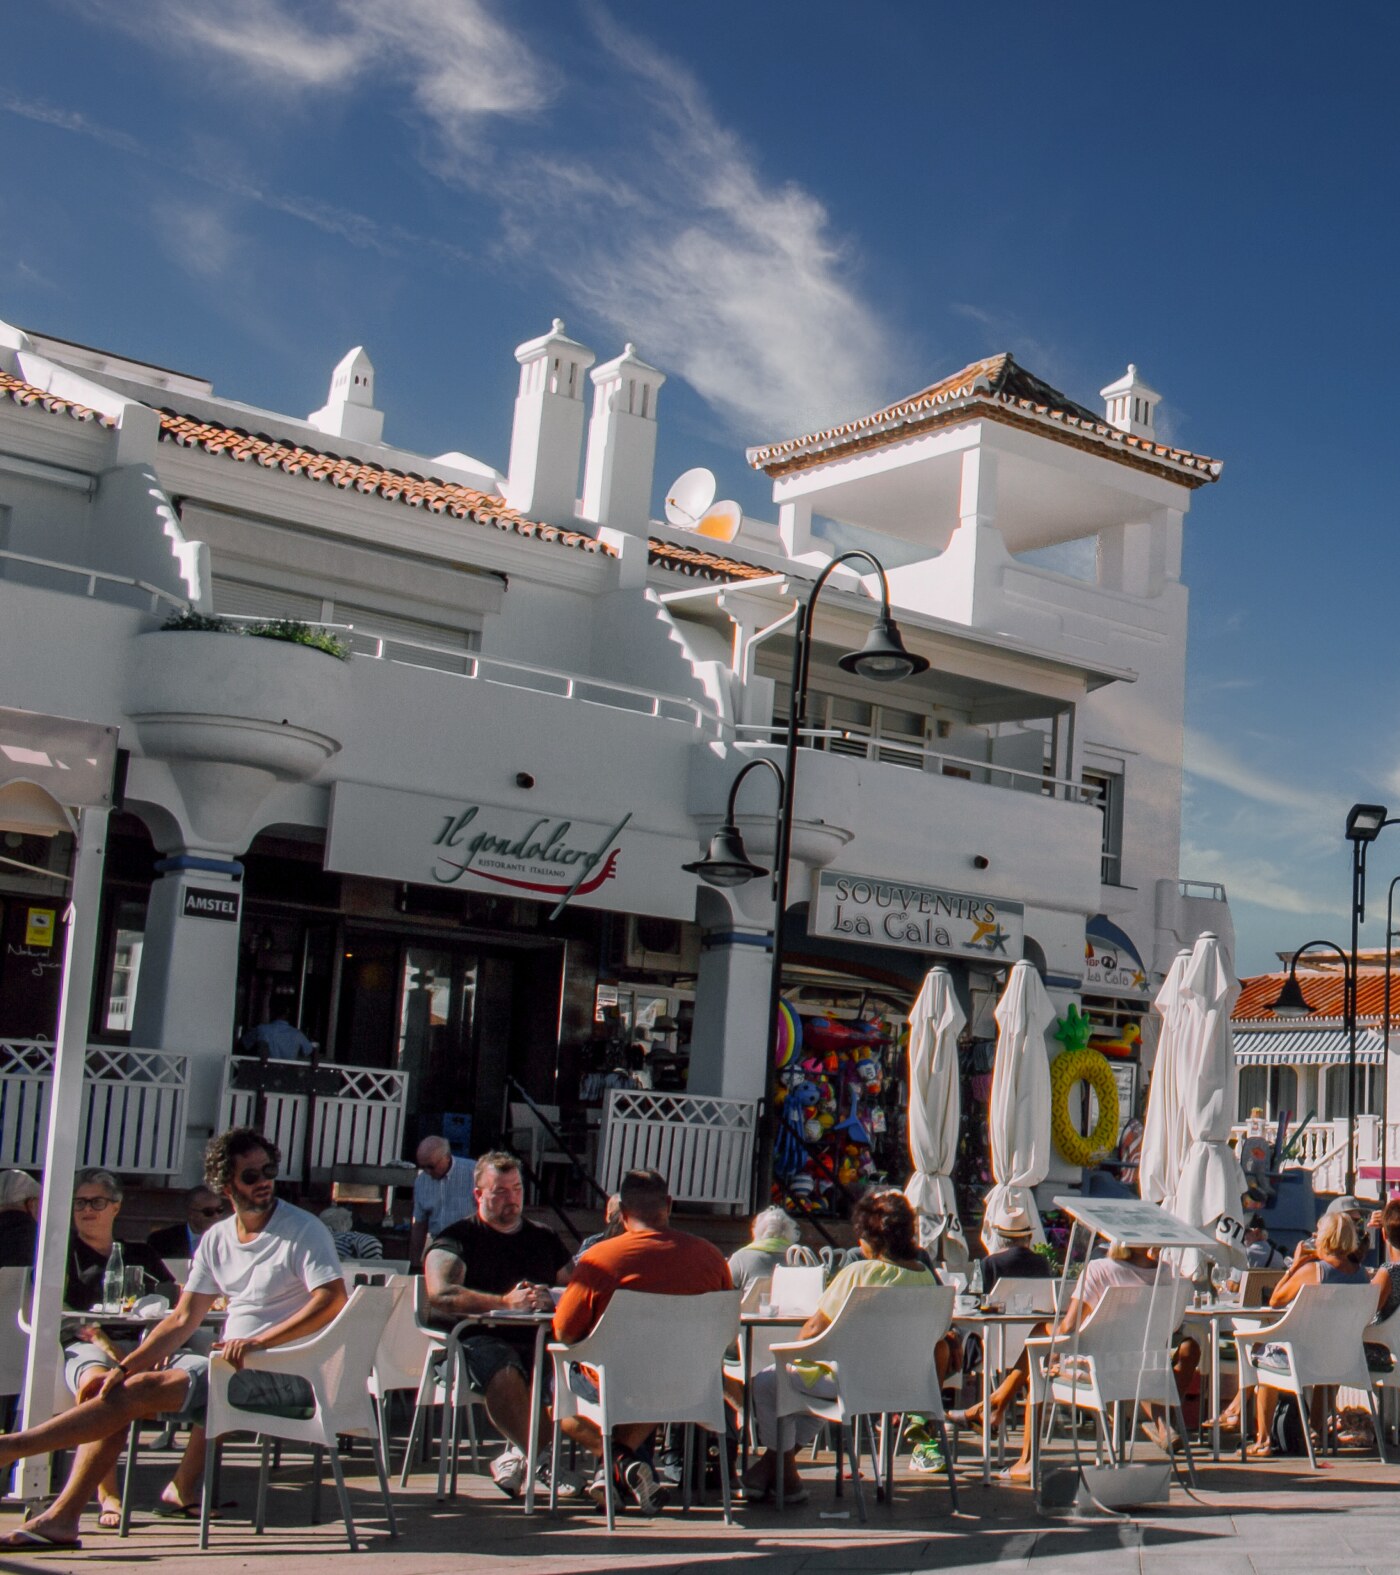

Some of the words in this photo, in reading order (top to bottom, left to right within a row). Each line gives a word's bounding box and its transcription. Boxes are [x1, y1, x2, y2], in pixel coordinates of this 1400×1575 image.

[433, 806, 480, 847] Il
[431, 818, 606, 884] gondoliero
[478, 859, 526, 872] RISTORANTE
[530, 867, 566, 878] ITALIANO
[186, 895, 236, 914] AMSTEL
[835, 879, 996, 923] SOUVENIRS
[833, 905, 872, 936] La
[883, 911, 951, 947] Cala
[1087, 968, 1101, 982] La
[1104, 971, 1129, 986] Cala
